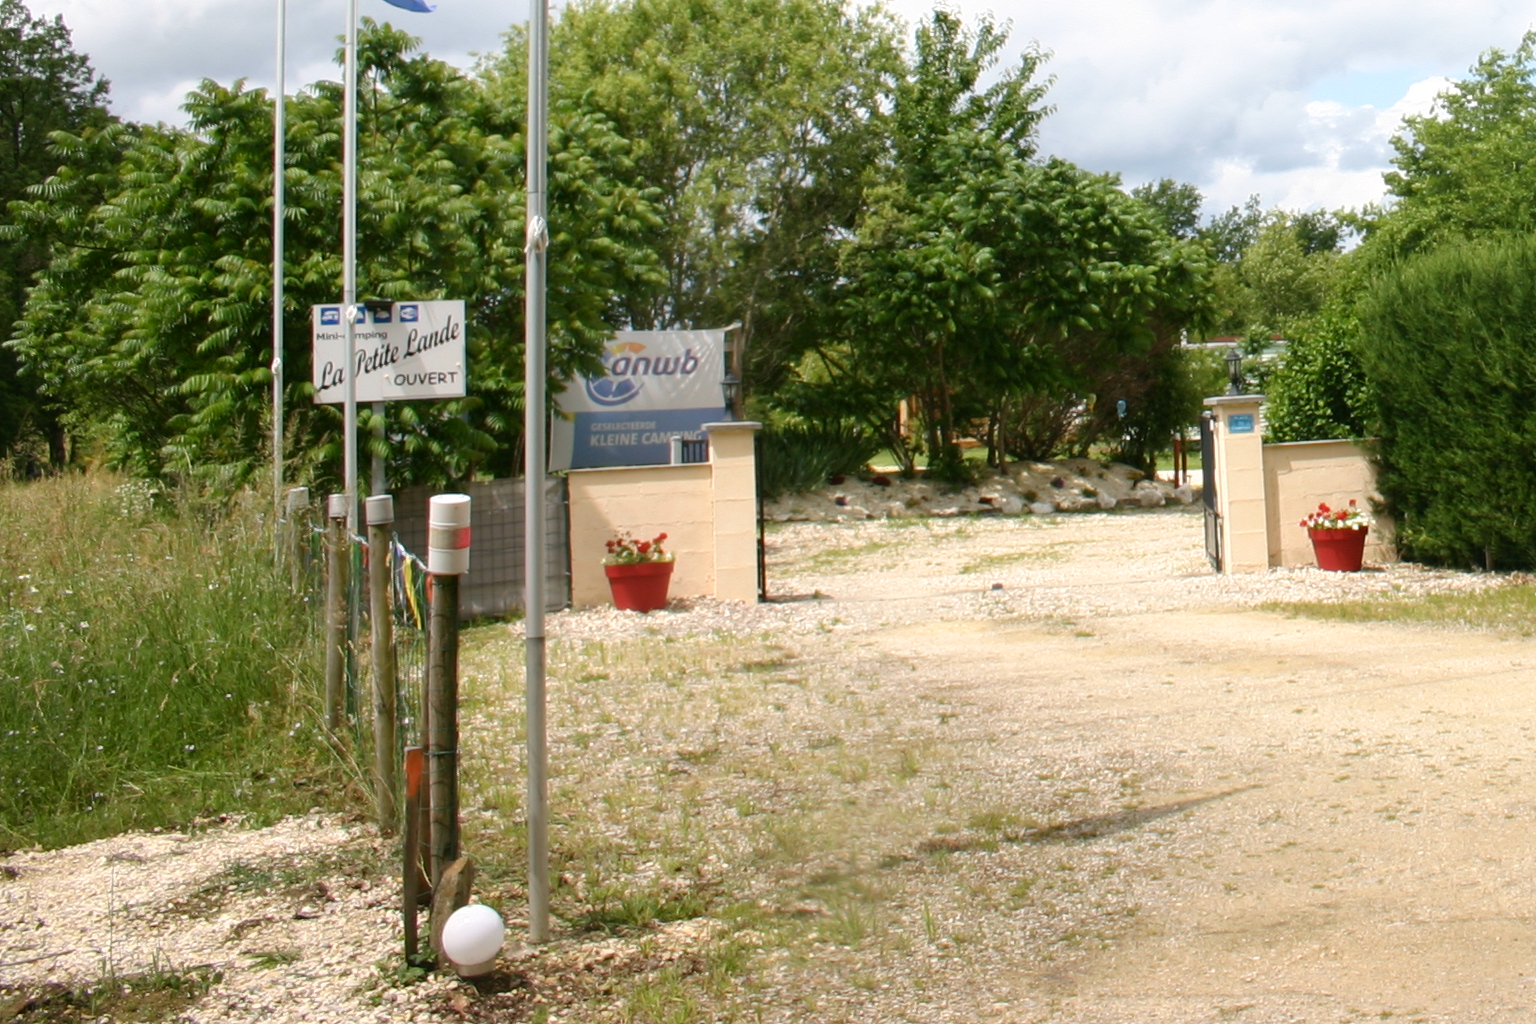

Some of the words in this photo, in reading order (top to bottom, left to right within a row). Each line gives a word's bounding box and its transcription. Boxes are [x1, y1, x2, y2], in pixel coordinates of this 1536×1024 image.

[316, 330, 388, 340] Mini-mping
[317, 361, 345, 392] La
[354, 343, 399, 378] Petite
[403, 314, 460, 359] Lande
[611, 349, 698, 376] anwb
[393, 371, 458, 386] OUVERT
[590, 433, 638, 446] KLEINE
